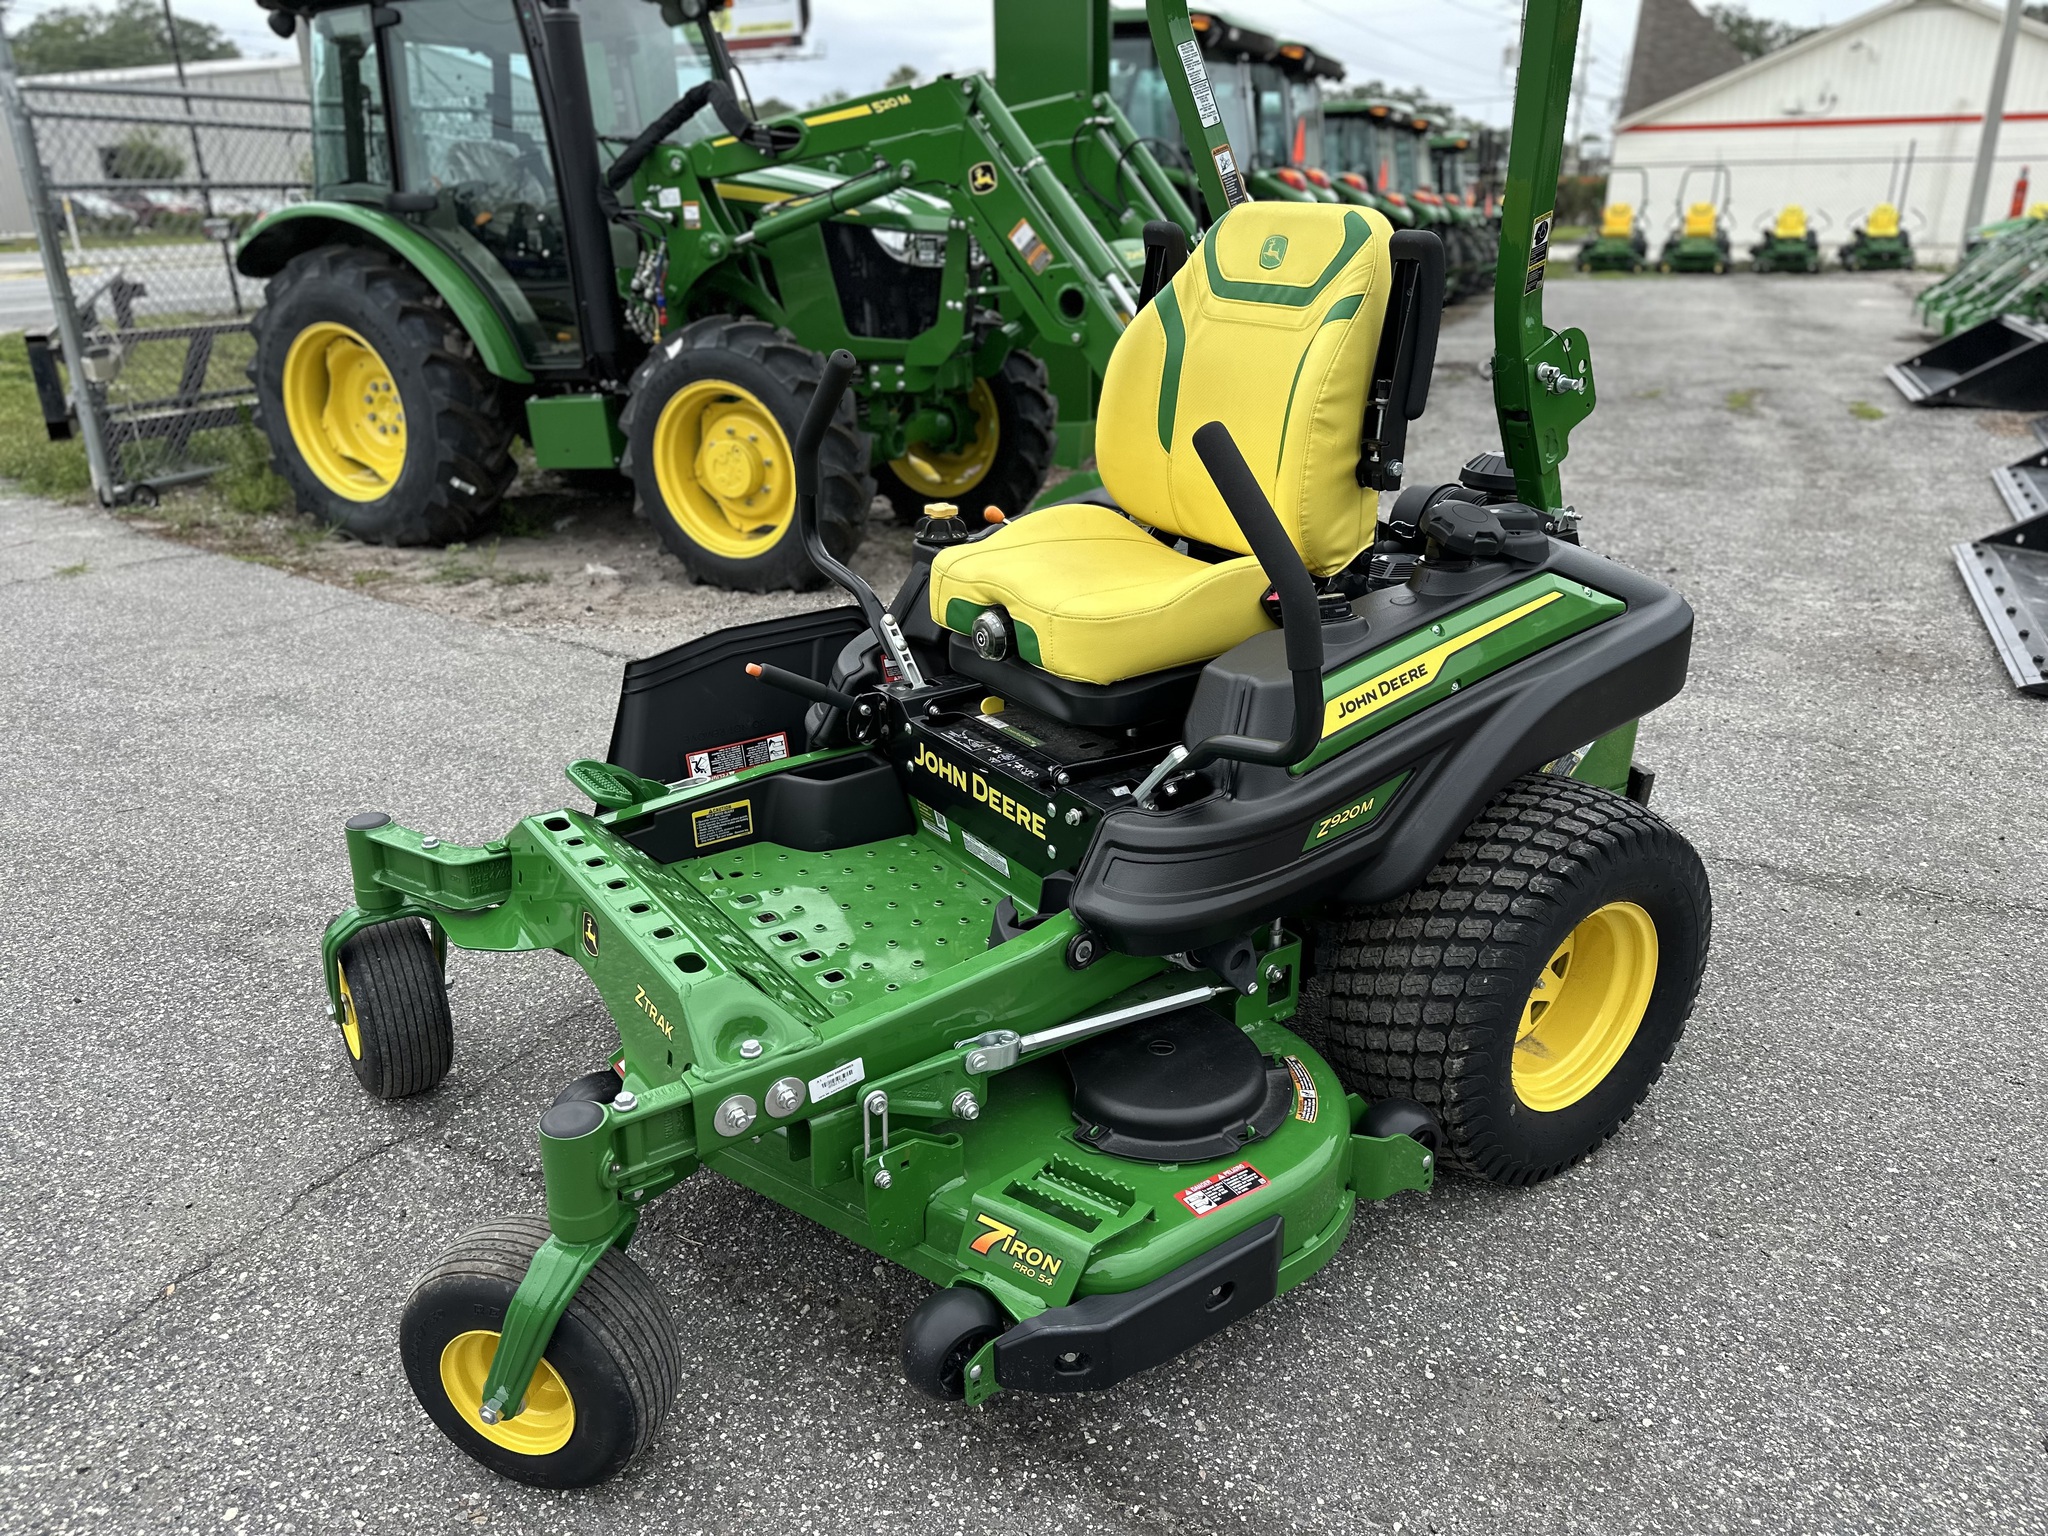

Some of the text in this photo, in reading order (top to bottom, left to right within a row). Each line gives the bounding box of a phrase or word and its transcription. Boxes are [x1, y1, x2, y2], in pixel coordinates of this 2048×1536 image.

[1338, 663, 1428, 719] JOHN DEERE
[914, 742, 967, 793] JOHN
[972, 771, 1046, 841] DEERE
[1316, 797, 1375, 839] Z920M
[634, 983, 675, 1042] ZTRAK
[1012, 1261, 1053, 1287] PRO 54
